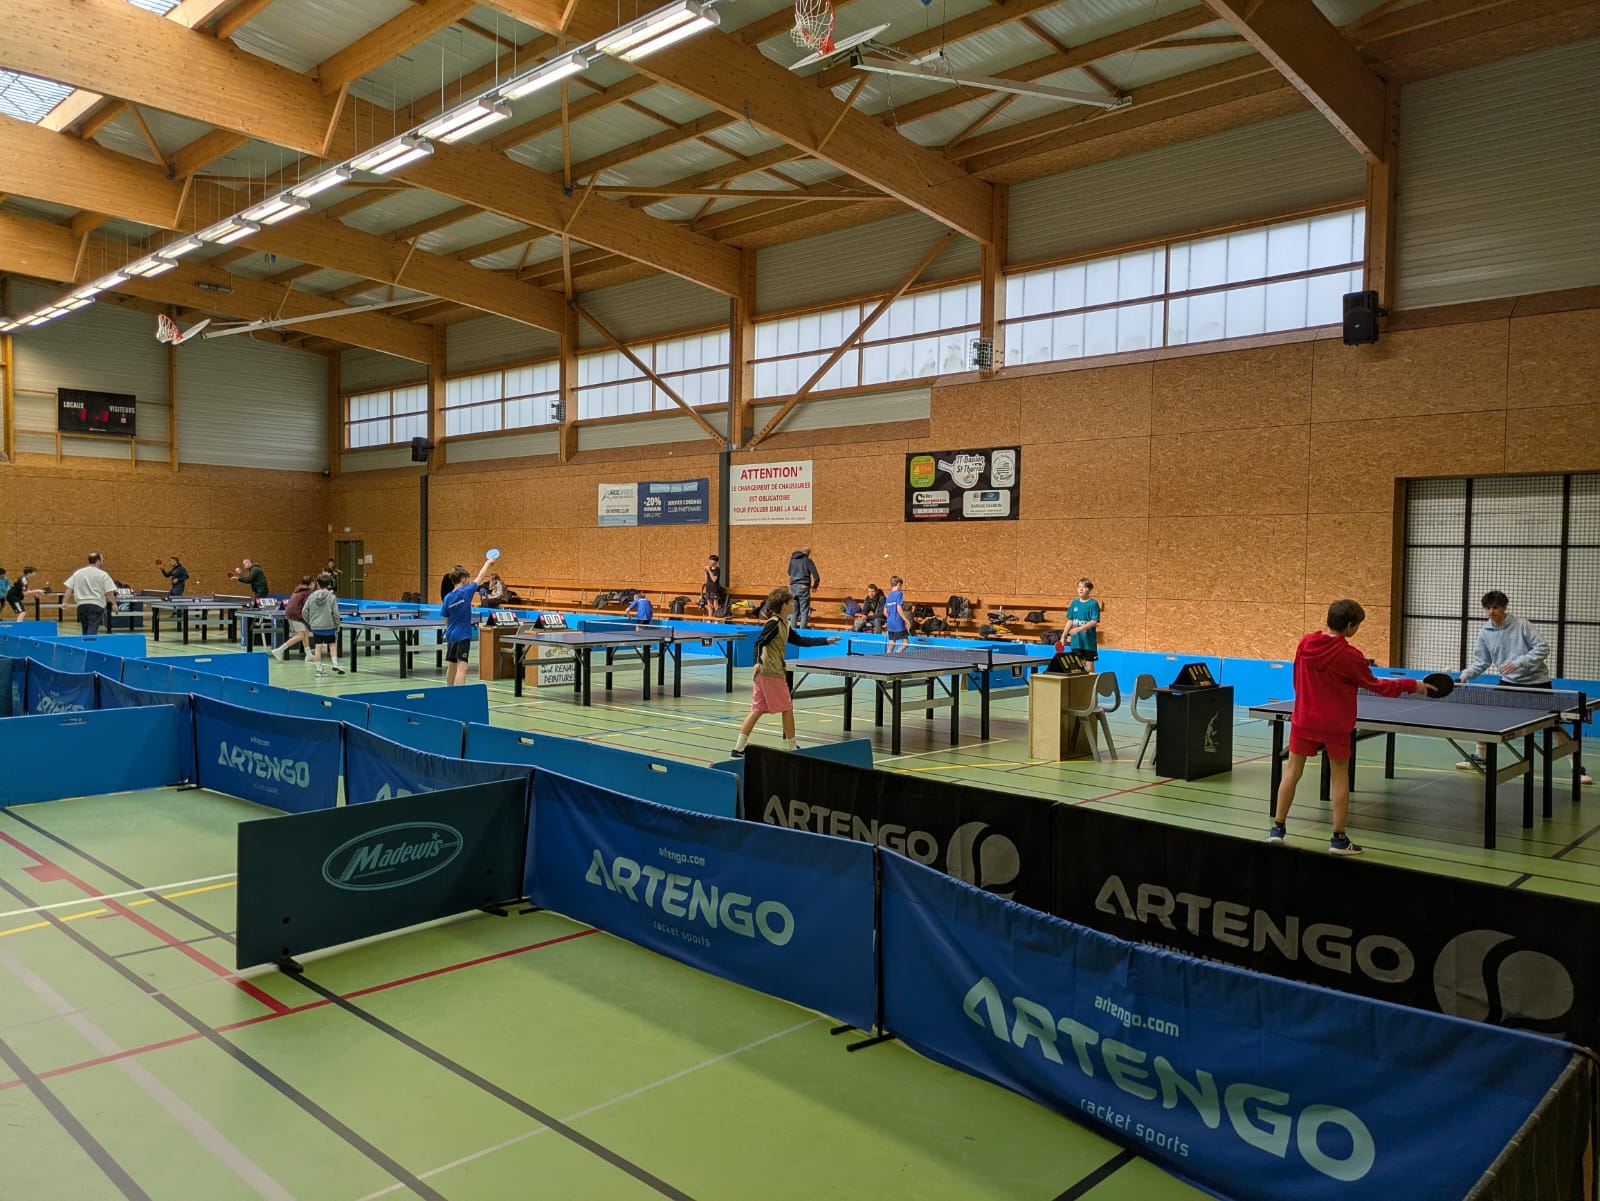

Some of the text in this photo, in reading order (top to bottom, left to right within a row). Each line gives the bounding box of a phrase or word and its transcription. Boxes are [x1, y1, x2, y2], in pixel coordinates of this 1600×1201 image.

[63, 401, 84, 409] LOCAUX
[109, 405, 136, 414] VISITEURS
[758, 494, 791, 502] OBLIGATOIRE
[778, 482, 811, 490] CHAUSSURES
[217, 740, 311, 788] ARTENGO
[762, 794, 939, 865] ARTENGO
[340, 832, 444, 881] Madewis
[585, 848, 796, 947] ARTENGO
[1094, 874, 1416, 984] ARTENGO
[1094, 995, 1180, 1038] artengo.com
[962, 976, 1376, 1182] ARTENGO
[1080, 1098, 1190, 1157] racket sports
